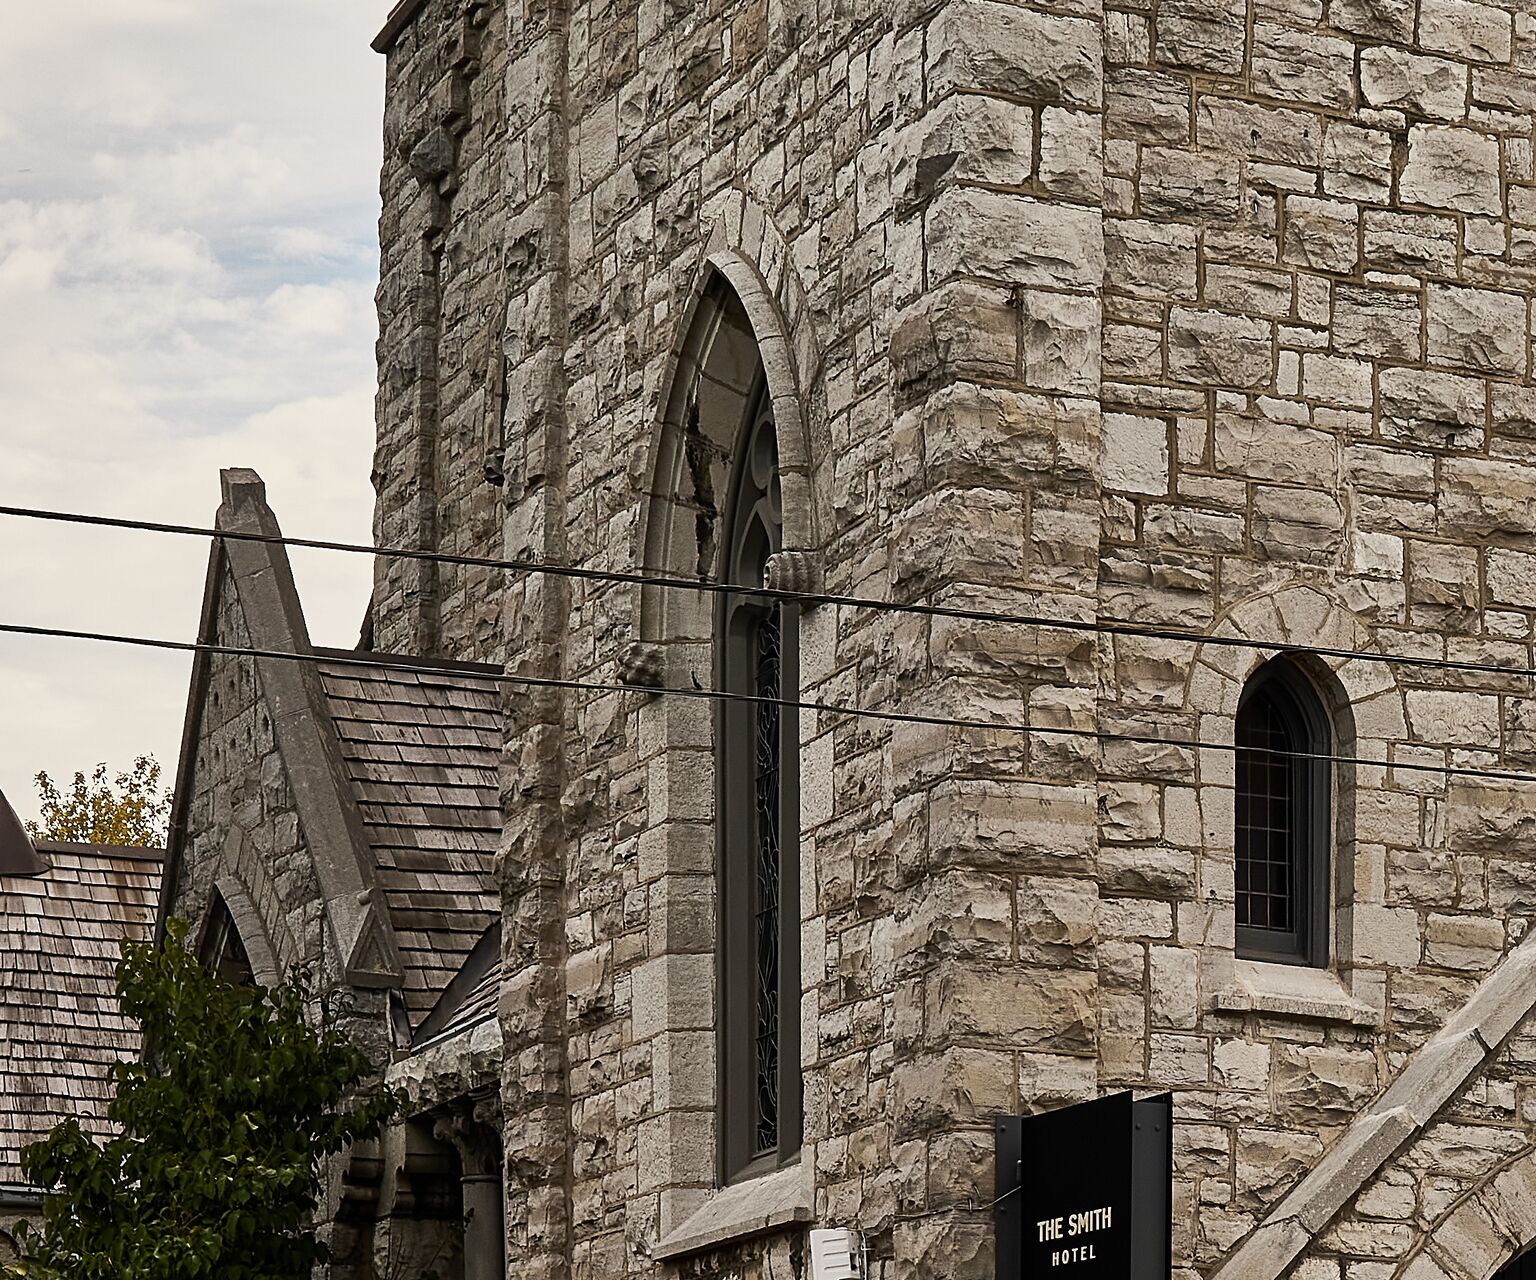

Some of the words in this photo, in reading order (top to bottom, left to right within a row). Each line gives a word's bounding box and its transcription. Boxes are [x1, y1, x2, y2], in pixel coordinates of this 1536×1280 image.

[1036, 1216, 1064, 1243] THE
[1067, 1206, 1112, 1236] SMITH
[1052, 1244, 1097, 1267] HOTEL
